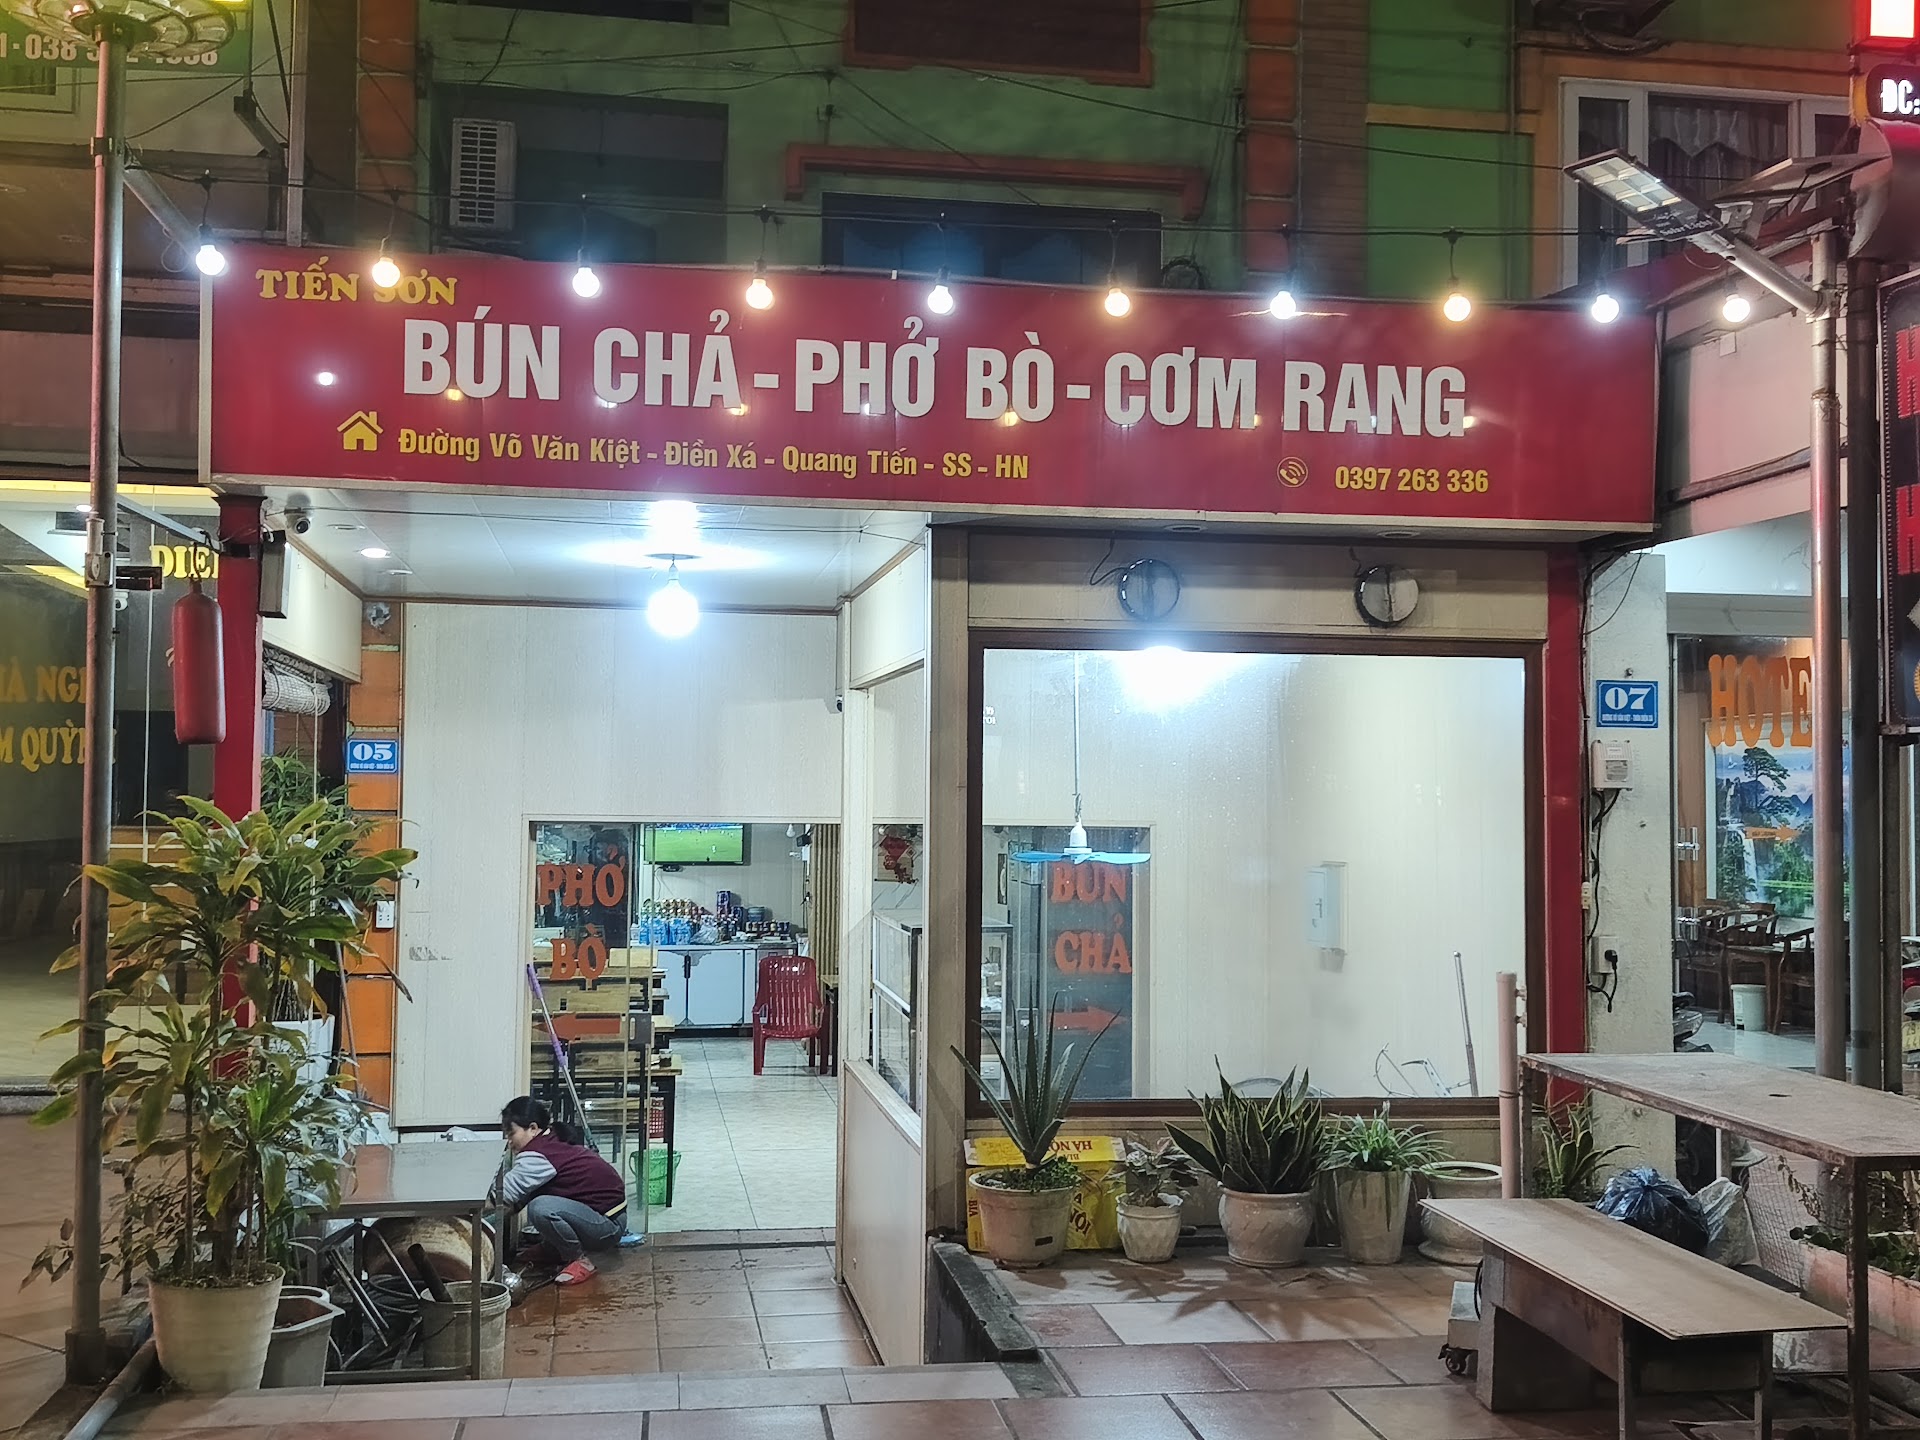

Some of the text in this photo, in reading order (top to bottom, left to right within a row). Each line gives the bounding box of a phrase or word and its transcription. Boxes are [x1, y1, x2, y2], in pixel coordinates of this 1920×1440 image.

[255, 256, 360, 302] TIẾN
[404, 306, 561, 401] BÚN
[593, 309, 742, 409] CHẢ
[795, 316, 940, 419] PHỞ
[966, 331, 1055, 422] BÒ
[1104, 346, 1257, 430] CƠM
[1283, 360, 1466, 438] RANG
[398, 428, 480, 462] Đường
[489, 432, 522, 459] Võ
[531, 434, 580, 461] Văn
[590, 437, 641, 469] Kiệt
[664, 438, 718, 468] Điền
[726, 442, 757, 469] Xá
[782, 445, 857, 479] Quang
[867, 447, 917, 475] Tiến
[942, 452, 972, 477] SS
[995, 454, 1029, 479] HN
[1335, 465, 1489, 493] 0397 263 336
[1604, 687, 1652, 710] 07
[353, 743, 393, 761] 05
[536, 843, 626, 907] PHỞ
[550, 923, 607, 980] BÒ
[1055, 912, 1132, 974] CHẢ
